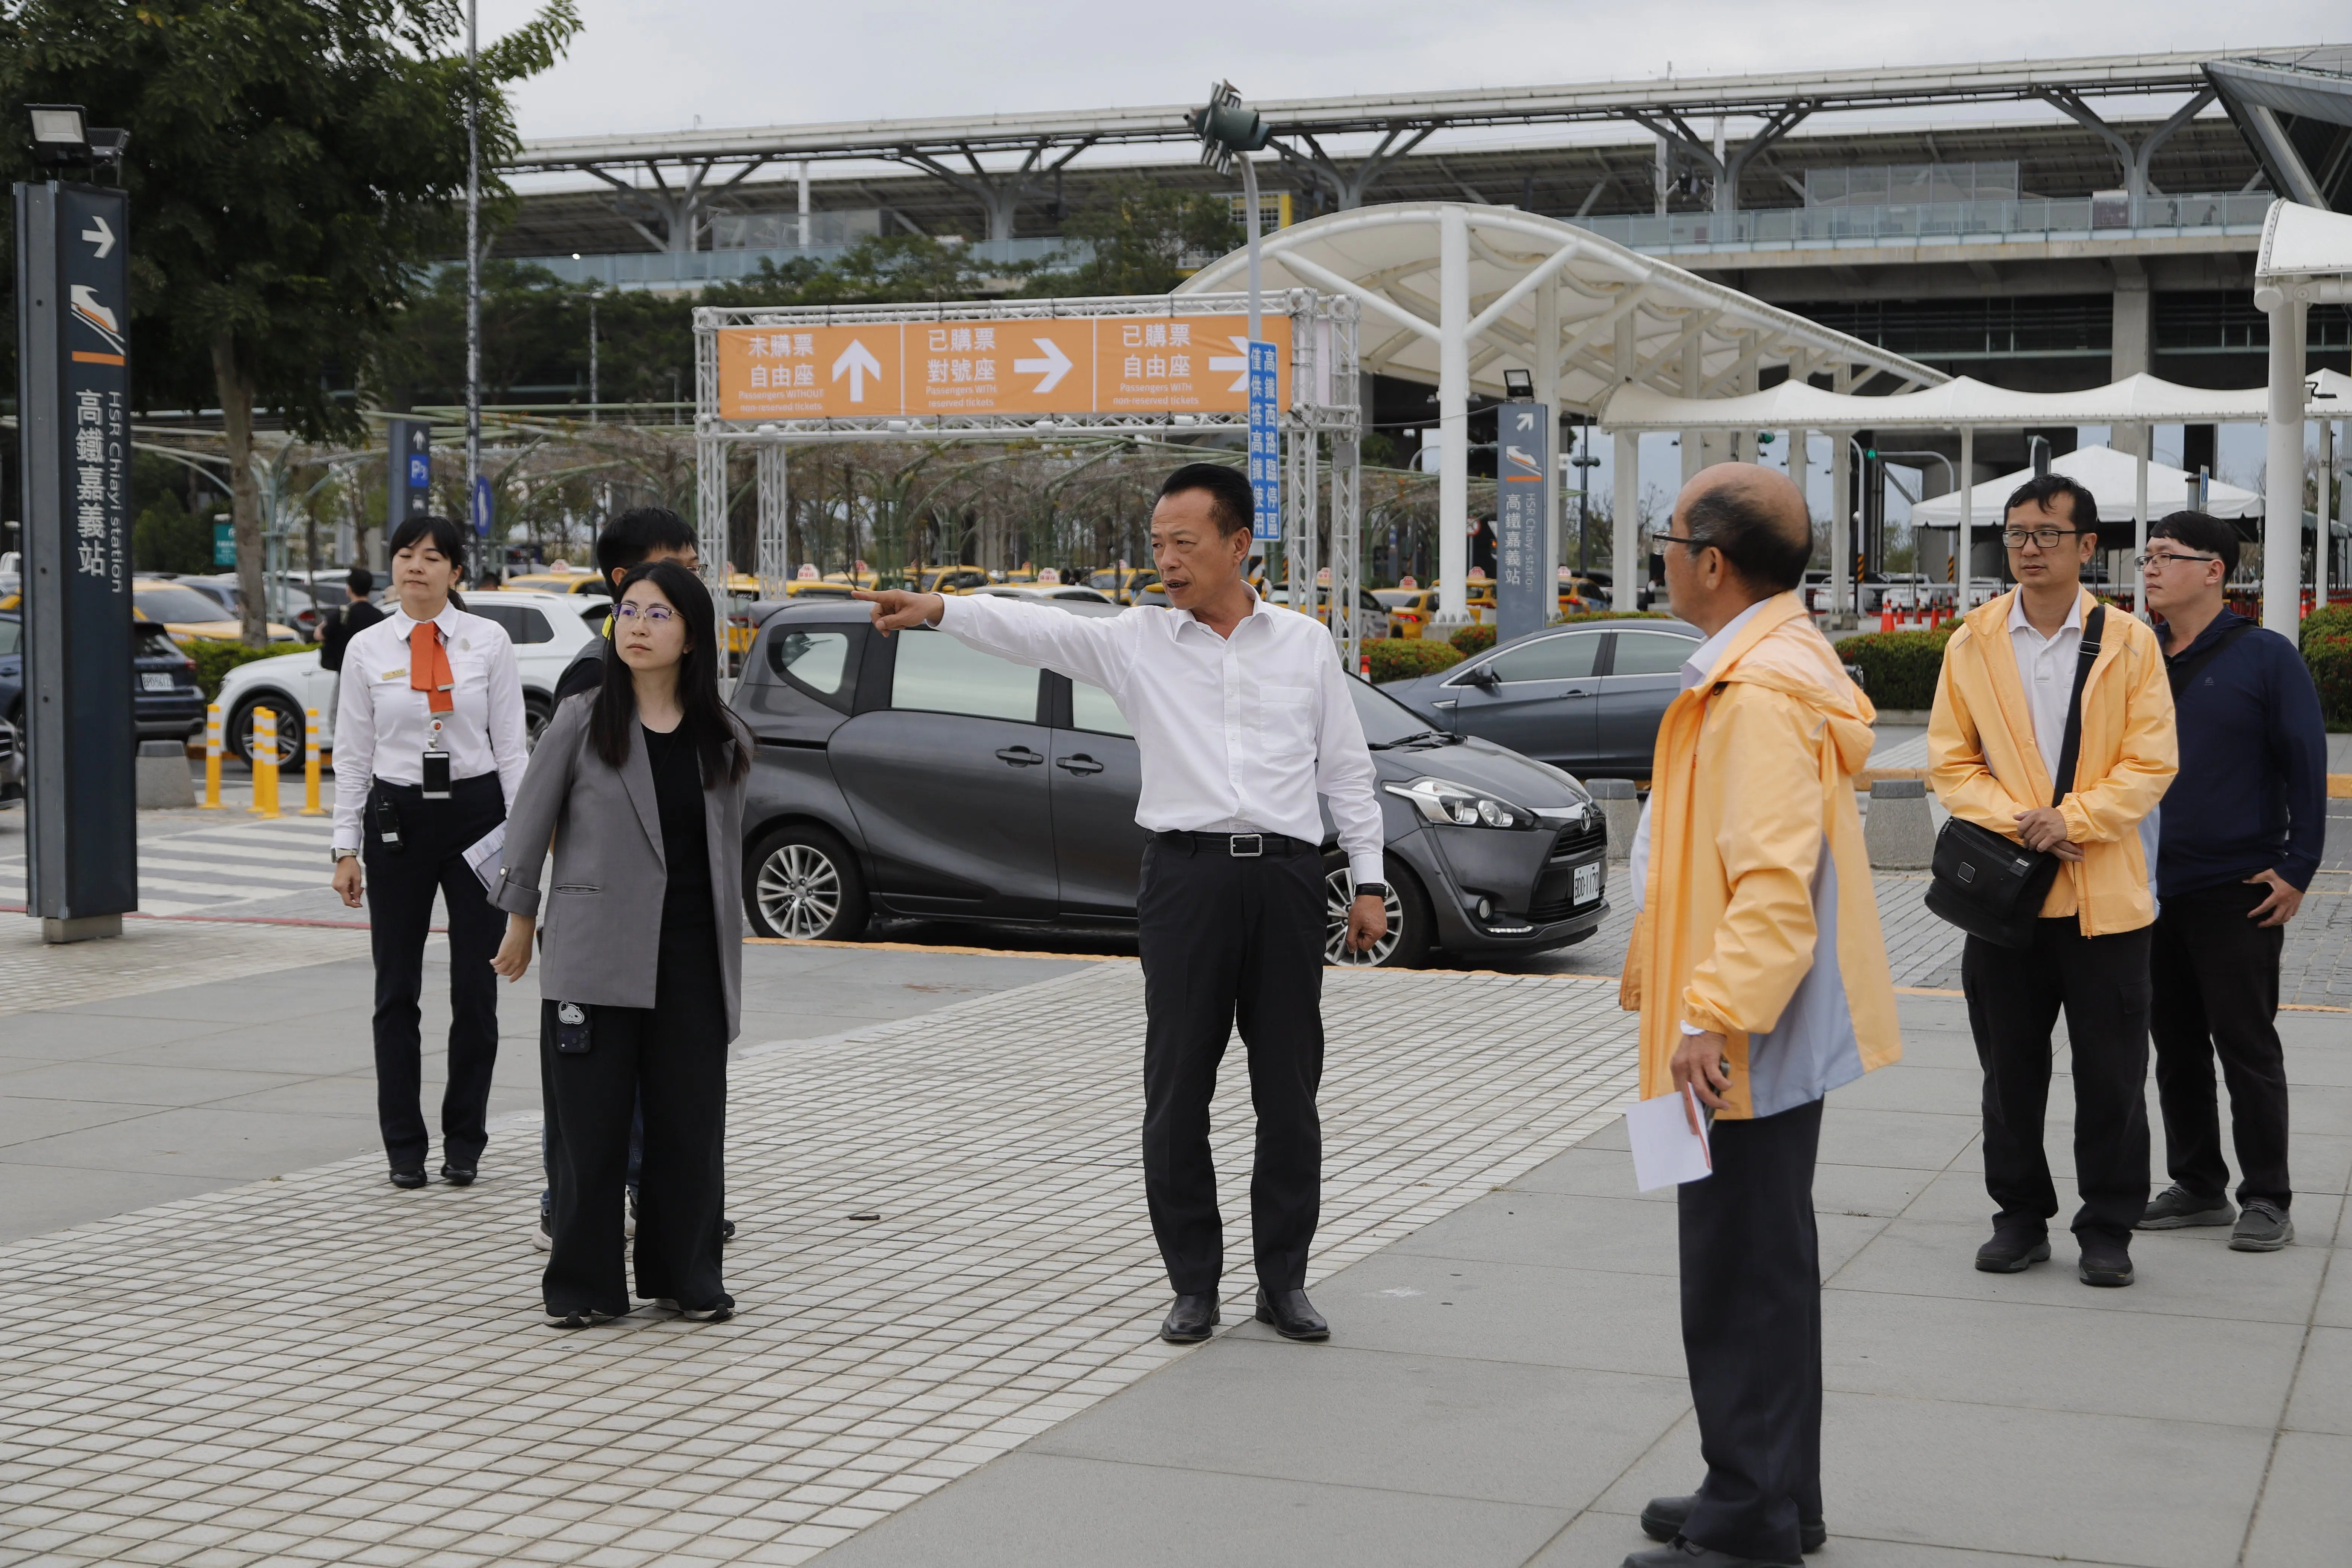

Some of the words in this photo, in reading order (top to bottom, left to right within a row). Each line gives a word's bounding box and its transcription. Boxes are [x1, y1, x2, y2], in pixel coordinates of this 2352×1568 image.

[748, 334, 815, 358] 未購票
[928, 328, 995, 352] 已購票
[1122, 323, 1190, 347] 已購票
[751, 363, 815, 387] 自由座
[927, 358, 995, 383] 對號座
[1124, 353, 1190, 378] 自由座
[739, 390, 784, 401] Passengers
[786, 389, 824, 398] WITHOUT
[926, 386, 973, 396] Passengers
[975, 384, 996, 394] WITH
[1113, 396, 1168, 405] non-reserved
[1170, 395, 1199, 404] tickets
[1120, 383, 1168, 393] Passengers
[1170, 383, 1192, 391] WITH
[109, 391, 122, 436] HSR
[740, 402, 793, 412] non-reserved
[795, 401, 822, 411] tickets
[928, 398, 963, 407] reserved
[966, 398, 994, 407] tickets
[1264, 349, 1279, 536] 高鐵西路臨停區
[107, 442, 123, 510] Chiayi
[411, 459, 428, 481] P3
[75, 389, 106, 577] 高鐵嘉義站
[1526, 493, 1536, 515] HSR
[1505, 493, 1521, 586] 高鐵嘉義站
[1524, 518, 1536, 552] Chiayi
[110, 516, 124, 593] station
[1525, 554, 1536, 591] station
[1575, 871, 1599, 899] BDD-1170
